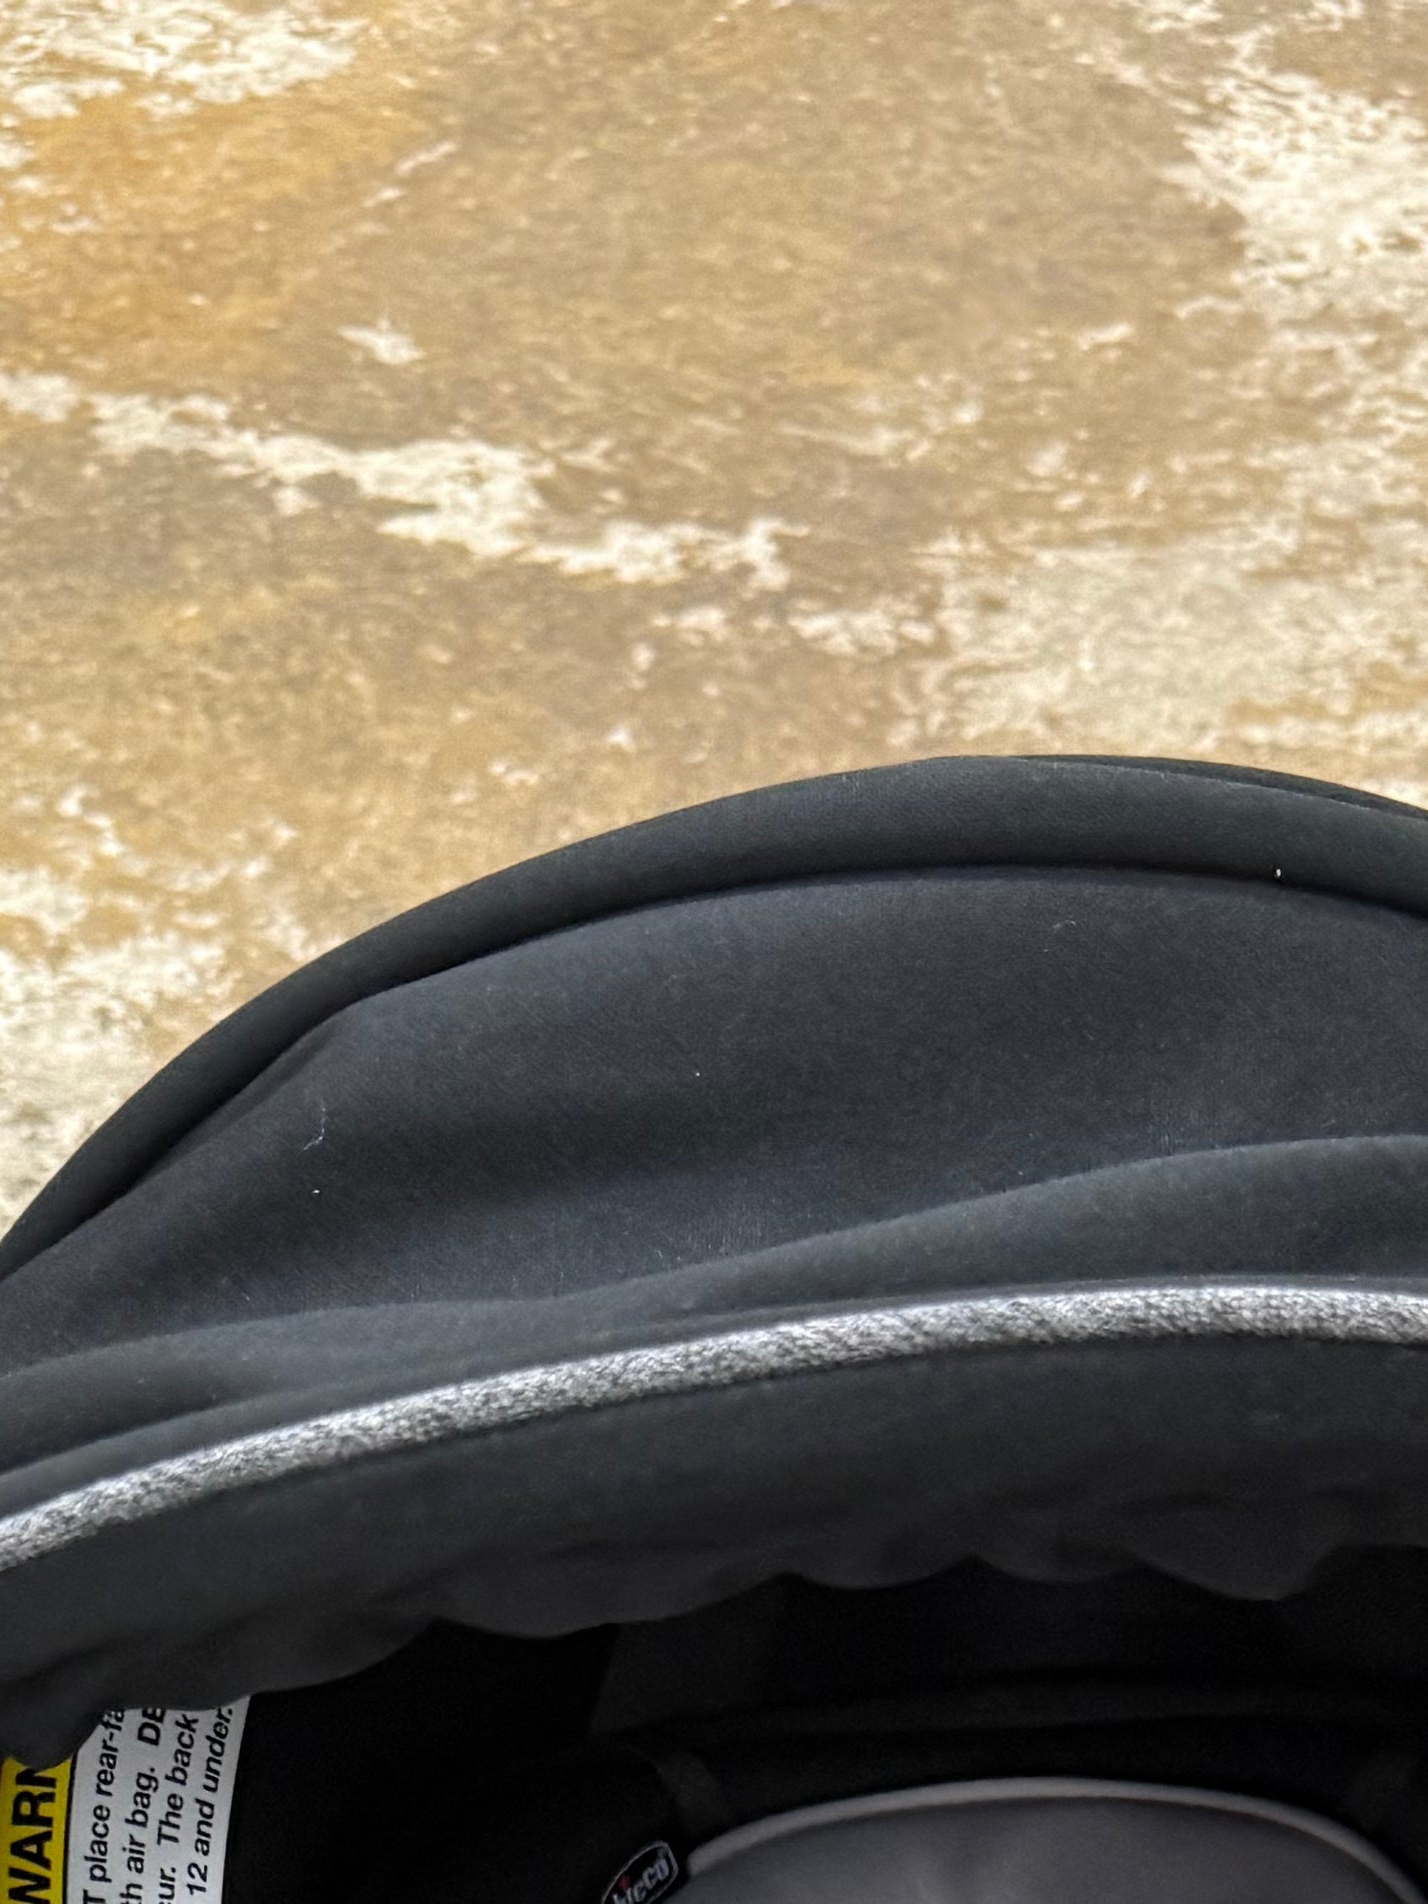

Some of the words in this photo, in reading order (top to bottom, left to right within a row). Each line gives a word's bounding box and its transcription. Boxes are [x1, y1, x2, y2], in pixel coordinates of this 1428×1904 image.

[165, 1713, 200, 1786] back
[203, 1707, 233, 1794] under.
[125, 1766, 159, 1828] bag.
[157, 1793, 184, 1845] The
[194, 1798, 215, 1856] and
[83, 1804, 112, 1883] place
[122, 1833, 145, 1875] air
[187, 1862, 208, 1895] 12
